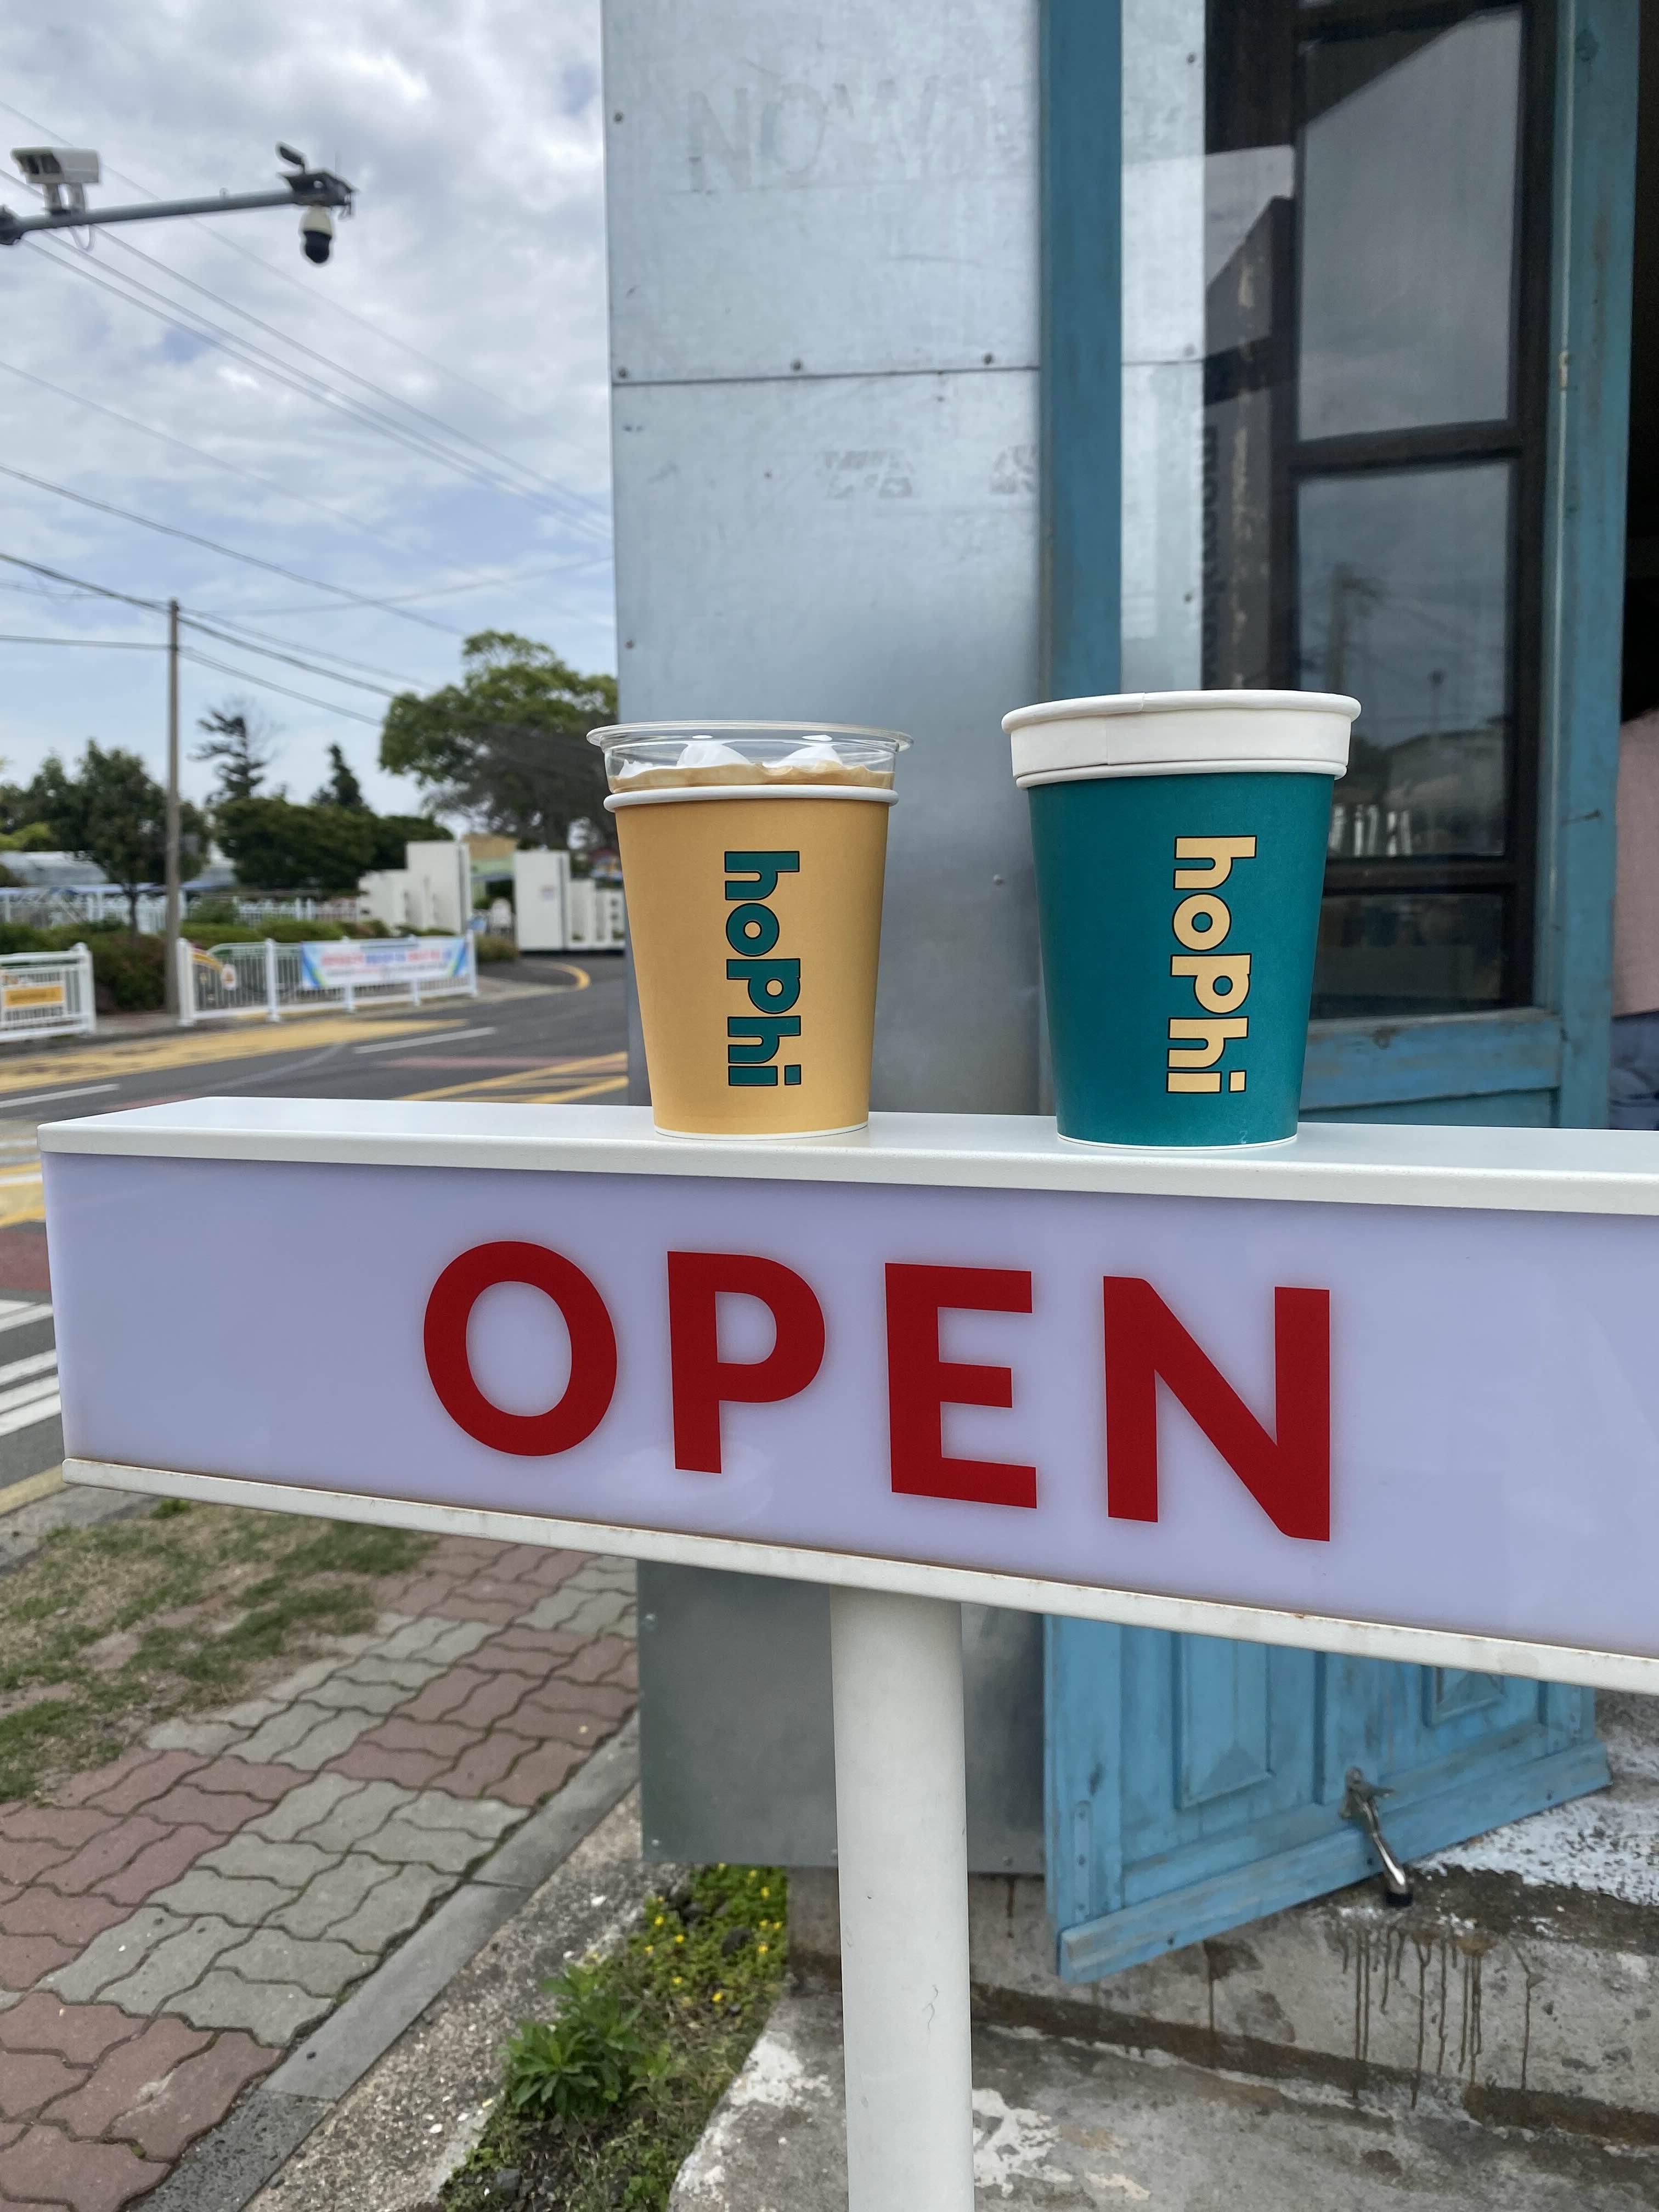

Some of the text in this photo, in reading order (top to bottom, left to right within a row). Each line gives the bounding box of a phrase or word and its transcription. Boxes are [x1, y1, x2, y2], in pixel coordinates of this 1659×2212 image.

[724, 851, 801, 1087] hophi
[1166, 835, 1257, 1093] hophi
[424, 1241, 1330, 1541] OPEN
